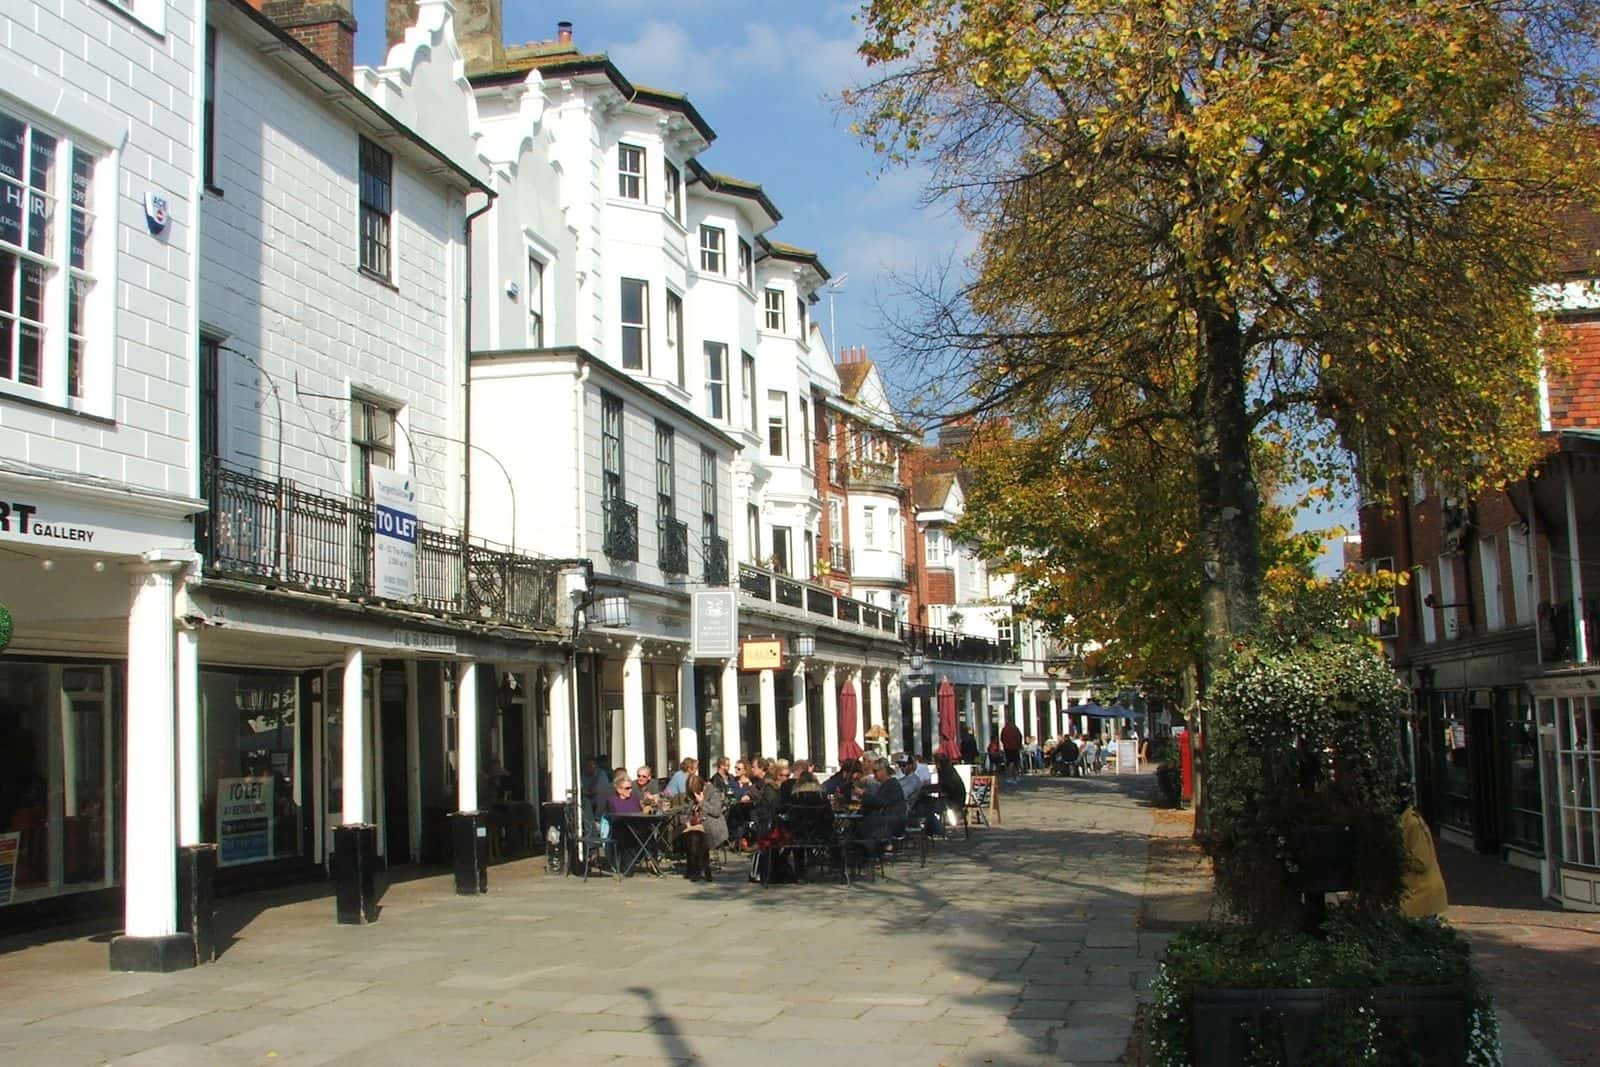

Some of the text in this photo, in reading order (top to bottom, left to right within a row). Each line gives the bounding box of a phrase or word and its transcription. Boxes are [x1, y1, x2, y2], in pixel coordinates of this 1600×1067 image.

[6, 185, 46, 218] HIR
[33, 523, 94, 543] GALLERY
[377, 510, 417, 538] TO LET
[230, 782, 262, 801] TO LET
